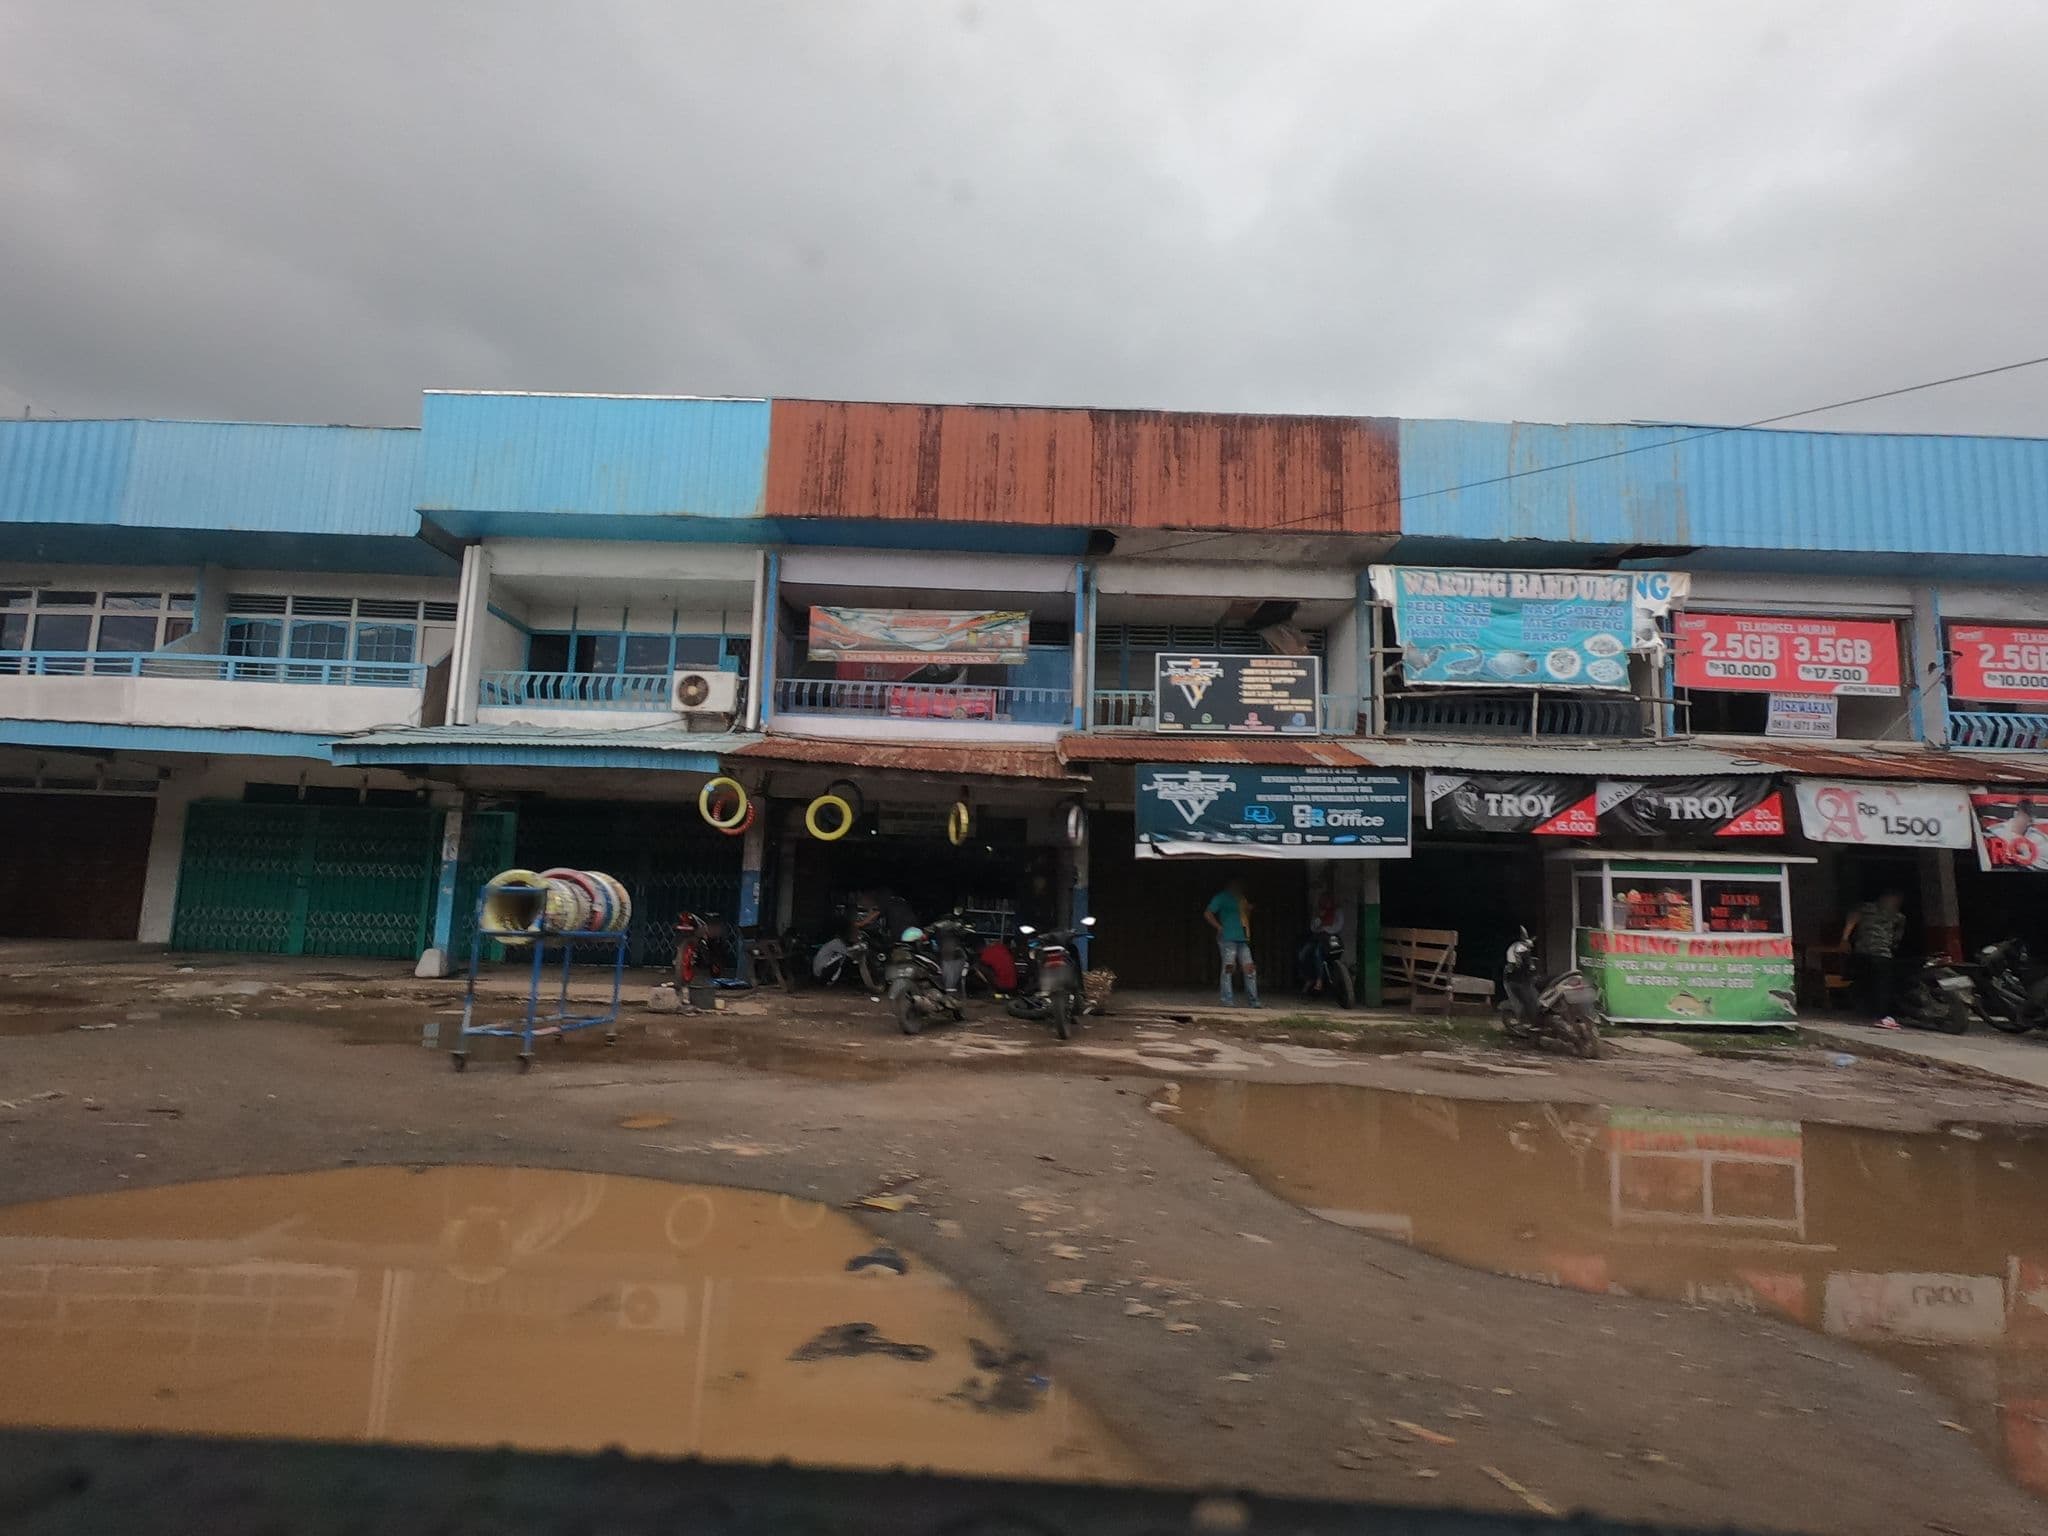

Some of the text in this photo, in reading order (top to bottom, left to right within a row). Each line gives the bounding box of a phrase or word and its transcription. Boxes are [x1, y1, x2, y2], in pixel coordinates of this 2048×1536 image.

[1402, 571, 1628, 600] WARUNG BANDUNG
[1407, 601, 1452, 612] PECEL
[1522, 604, 1625, 617] NASI GORENG
[1407, 615, 1448, 625] PECEL
[1556, 618, 1625, 631] GRENG
[1701, 631, 1872, 665] 2.5GB 3.5GB
[1721, 662, 1771, 677] 10.000
[1814, 667, 1862, 681] 17.500
[1484, 792, 1555, 817] TROY
[1663, 796, 1737, 819] TROY
[1858, 802, 1879, 818] Rp
[1326, 814, 1385, 827] Office
[1881, 816, 1941, 837] 1.500
